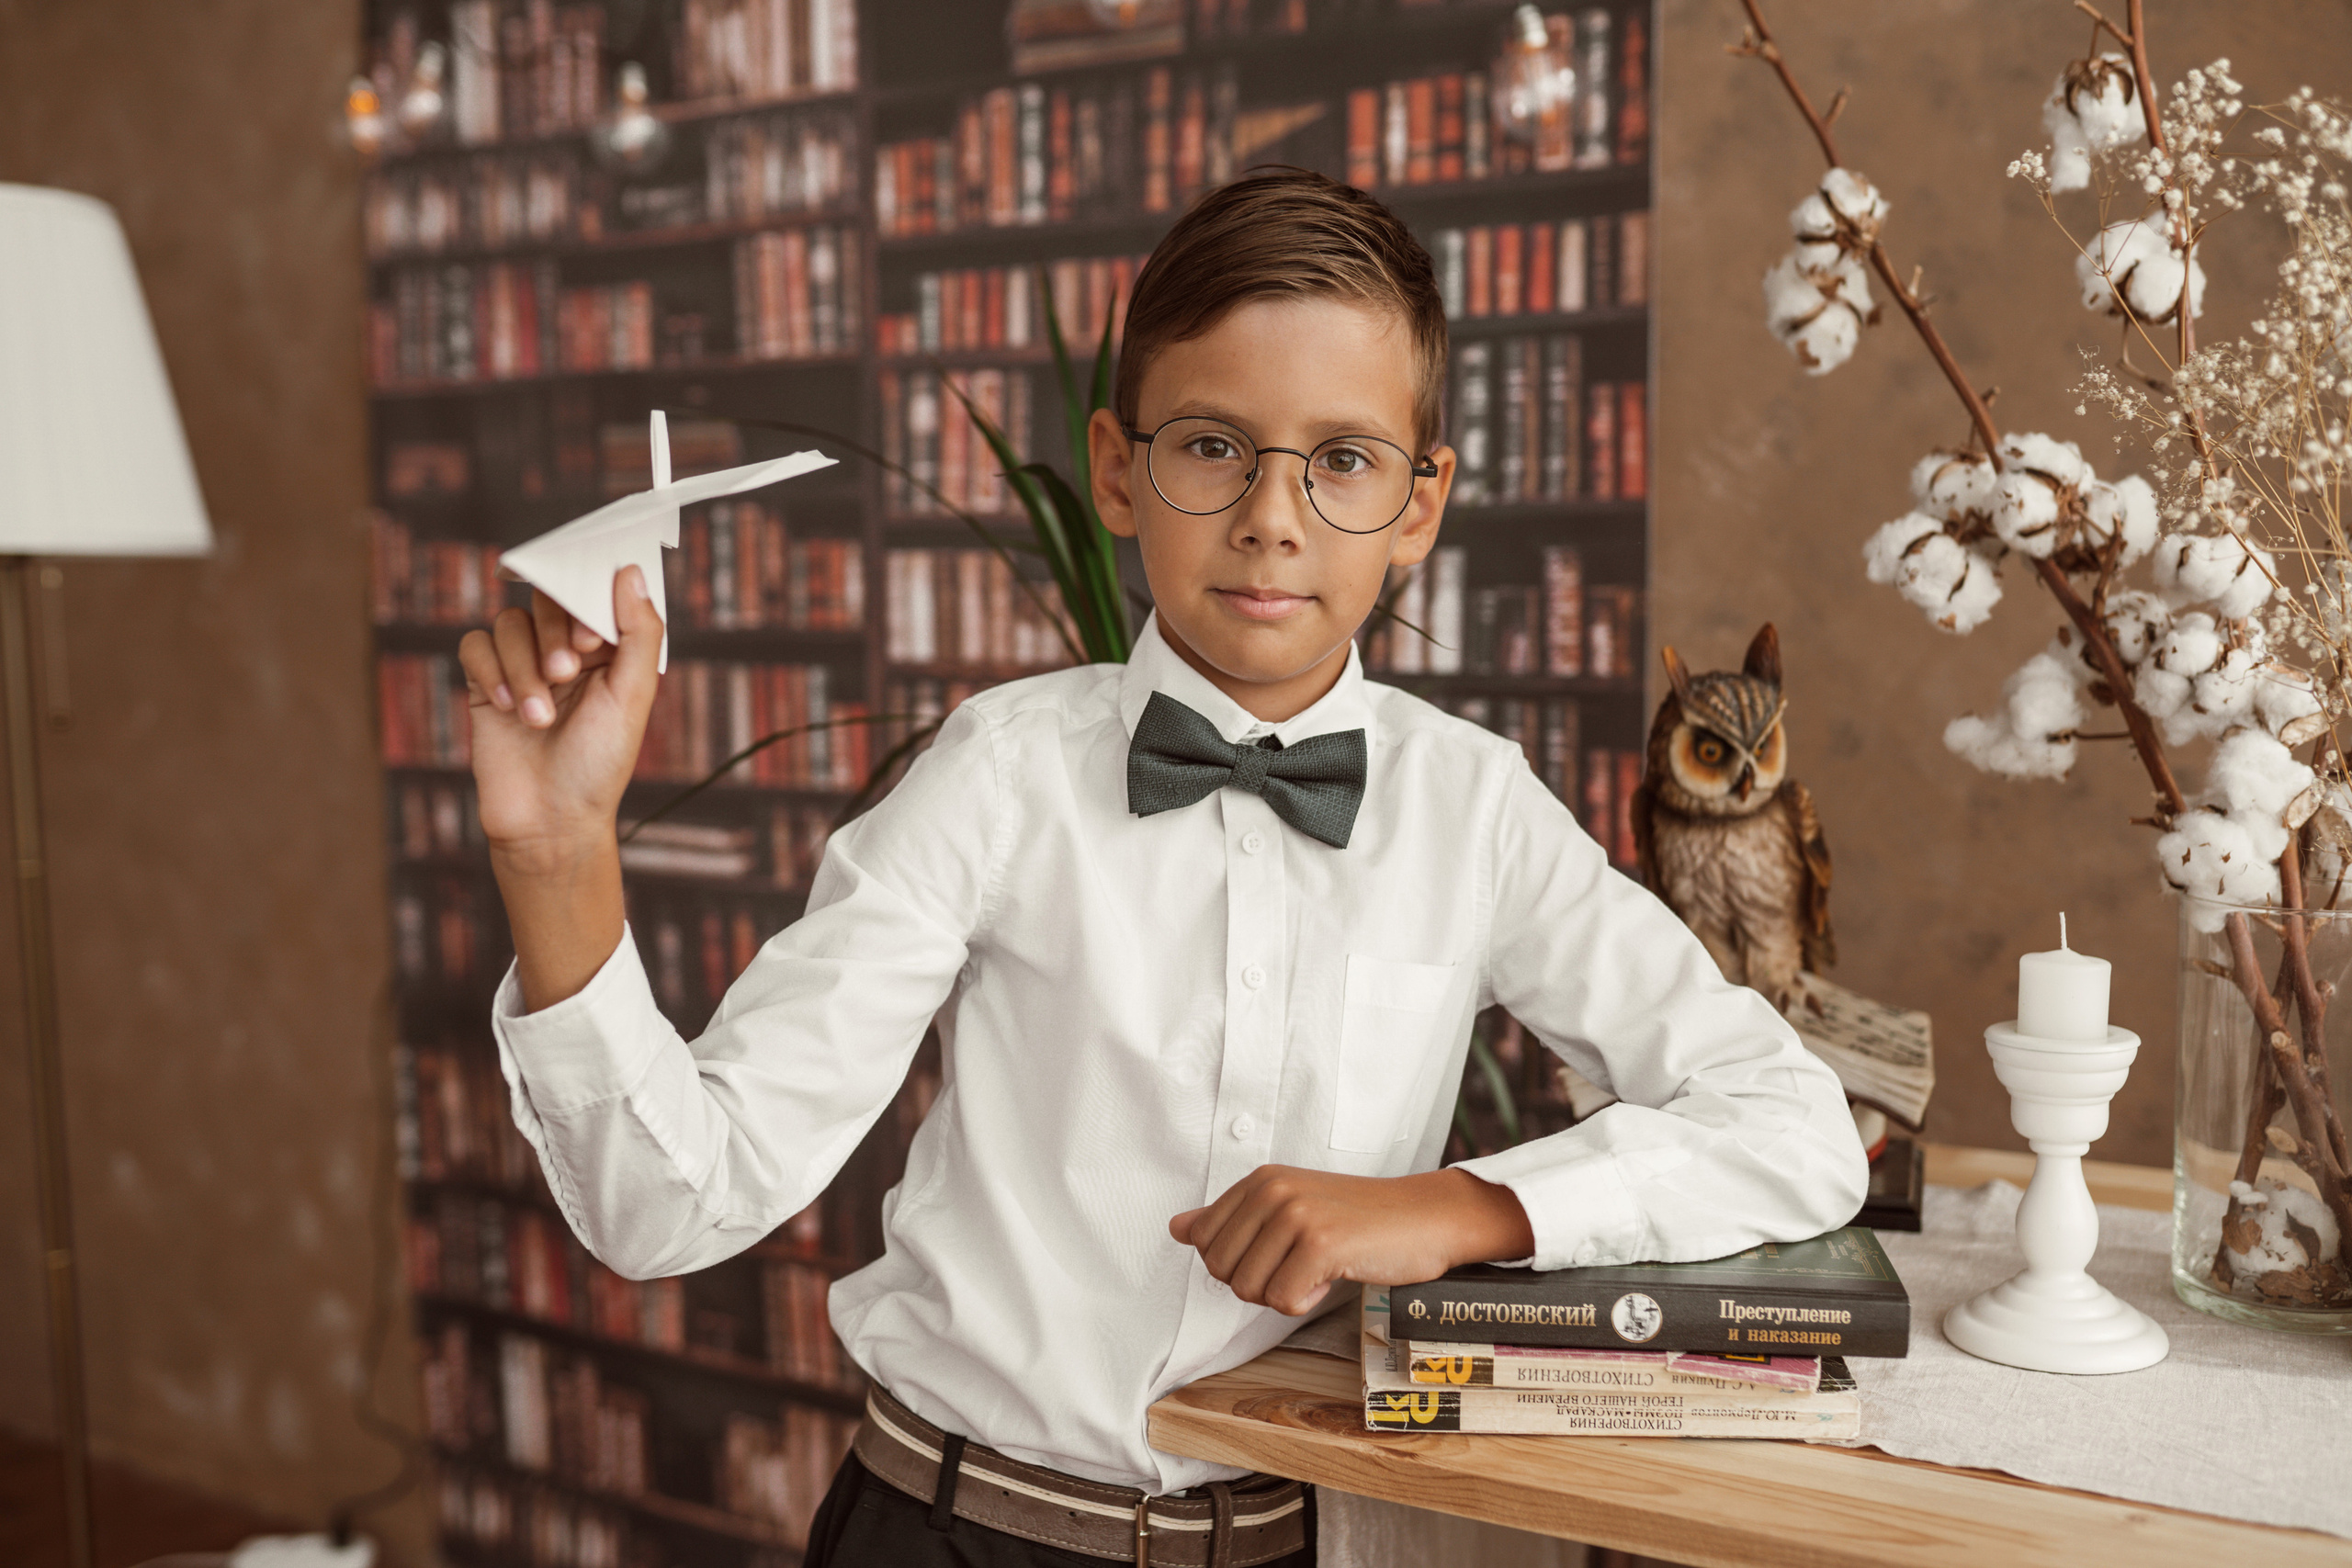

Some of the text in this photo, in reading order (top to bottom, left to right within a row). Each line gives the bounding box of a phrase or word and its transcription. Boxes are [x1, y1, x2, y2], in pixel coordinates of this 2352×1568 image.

[1408, 1299, 1431, 1321] Ф.
[1440, 1301, 1597, 1326] ДОСТОЕВСКИЙ
[1719, 1299, 1851, 1325] Преступление
[1727, 1328, 1842, 1345] и наказание
[1517, 1368, 1655, 1386] СТИХОТВОРЕНИЯ
[1517, 1393, 1683, 1408] ГЕРОЙ НАШЕГО ВРЕМЕНИ
[1569, 1417, 1683, 1430] СТИХОТВОРЕНИЯ
